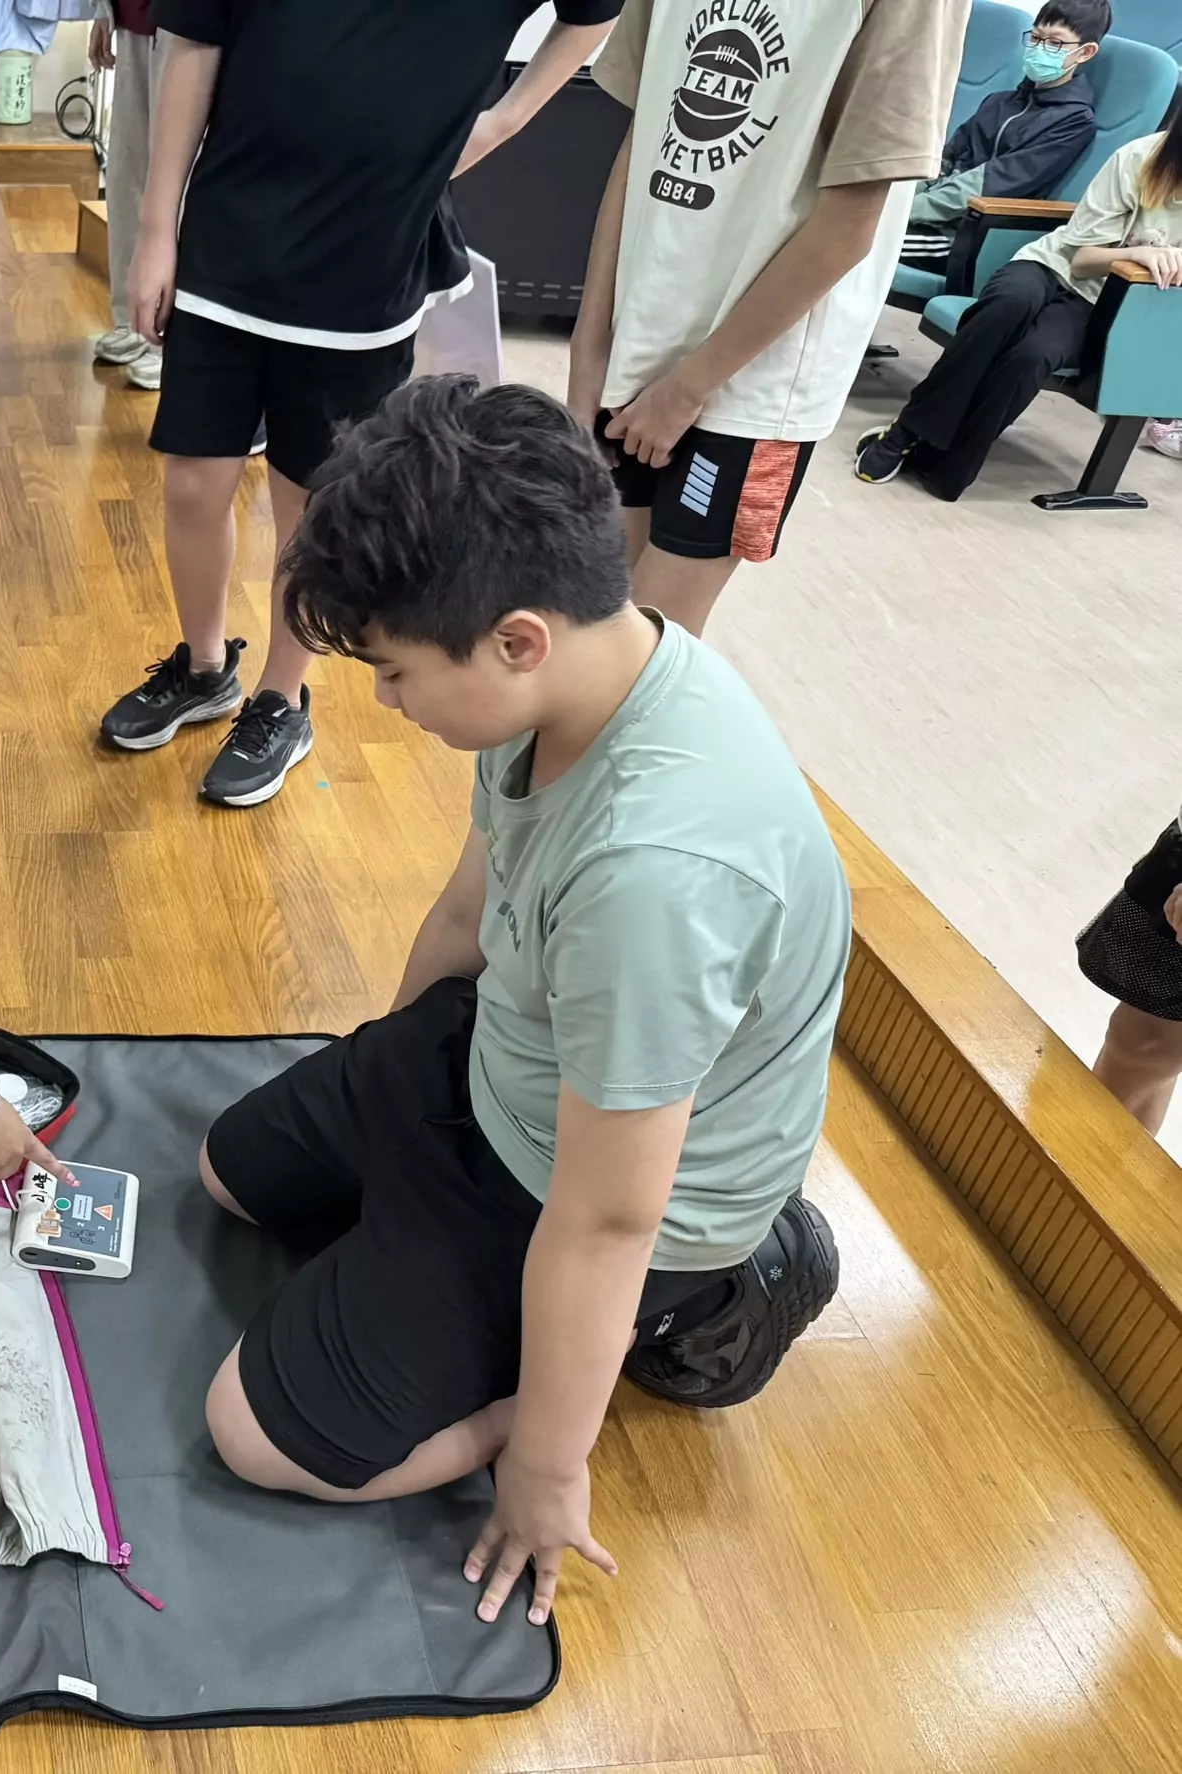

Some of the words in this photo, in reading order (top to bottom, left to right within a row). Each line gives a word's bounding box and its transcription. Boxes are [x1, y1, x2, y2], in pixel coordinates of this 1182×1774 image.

[685, 0, 790, 79] WORLDWIDE
[682, 66, 754, 104] TEAM
[661, 88, 779, 174] KETBALL
[657, 177, 696, 204] 1984
